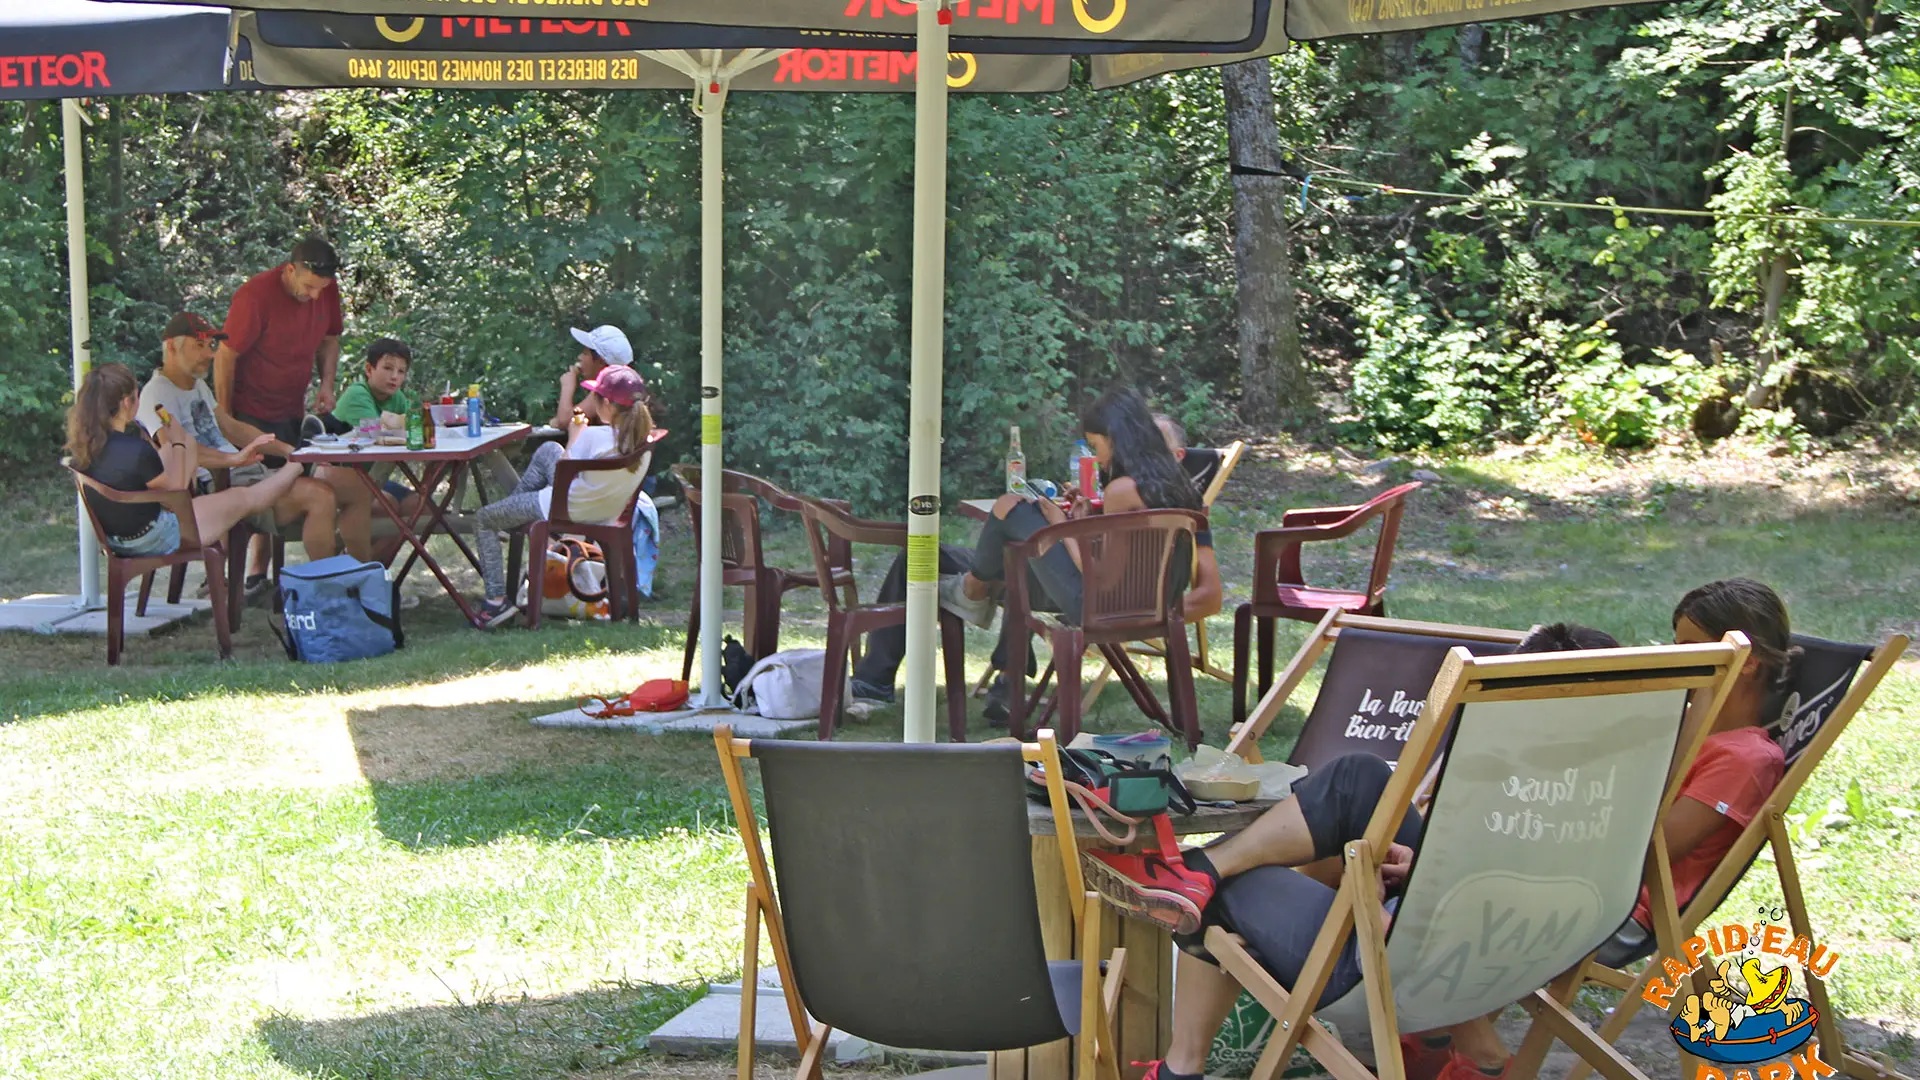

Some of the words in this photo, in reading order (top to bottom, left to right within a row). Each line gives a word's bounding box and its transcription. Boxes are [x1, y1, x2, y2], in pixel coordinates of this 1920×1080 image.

[0, 51, 111, 87] ETEOR
[239, 60, 255, 81] DE
[284, 607, 316, 630] ard
[1358, 688, 1385, 716] La
